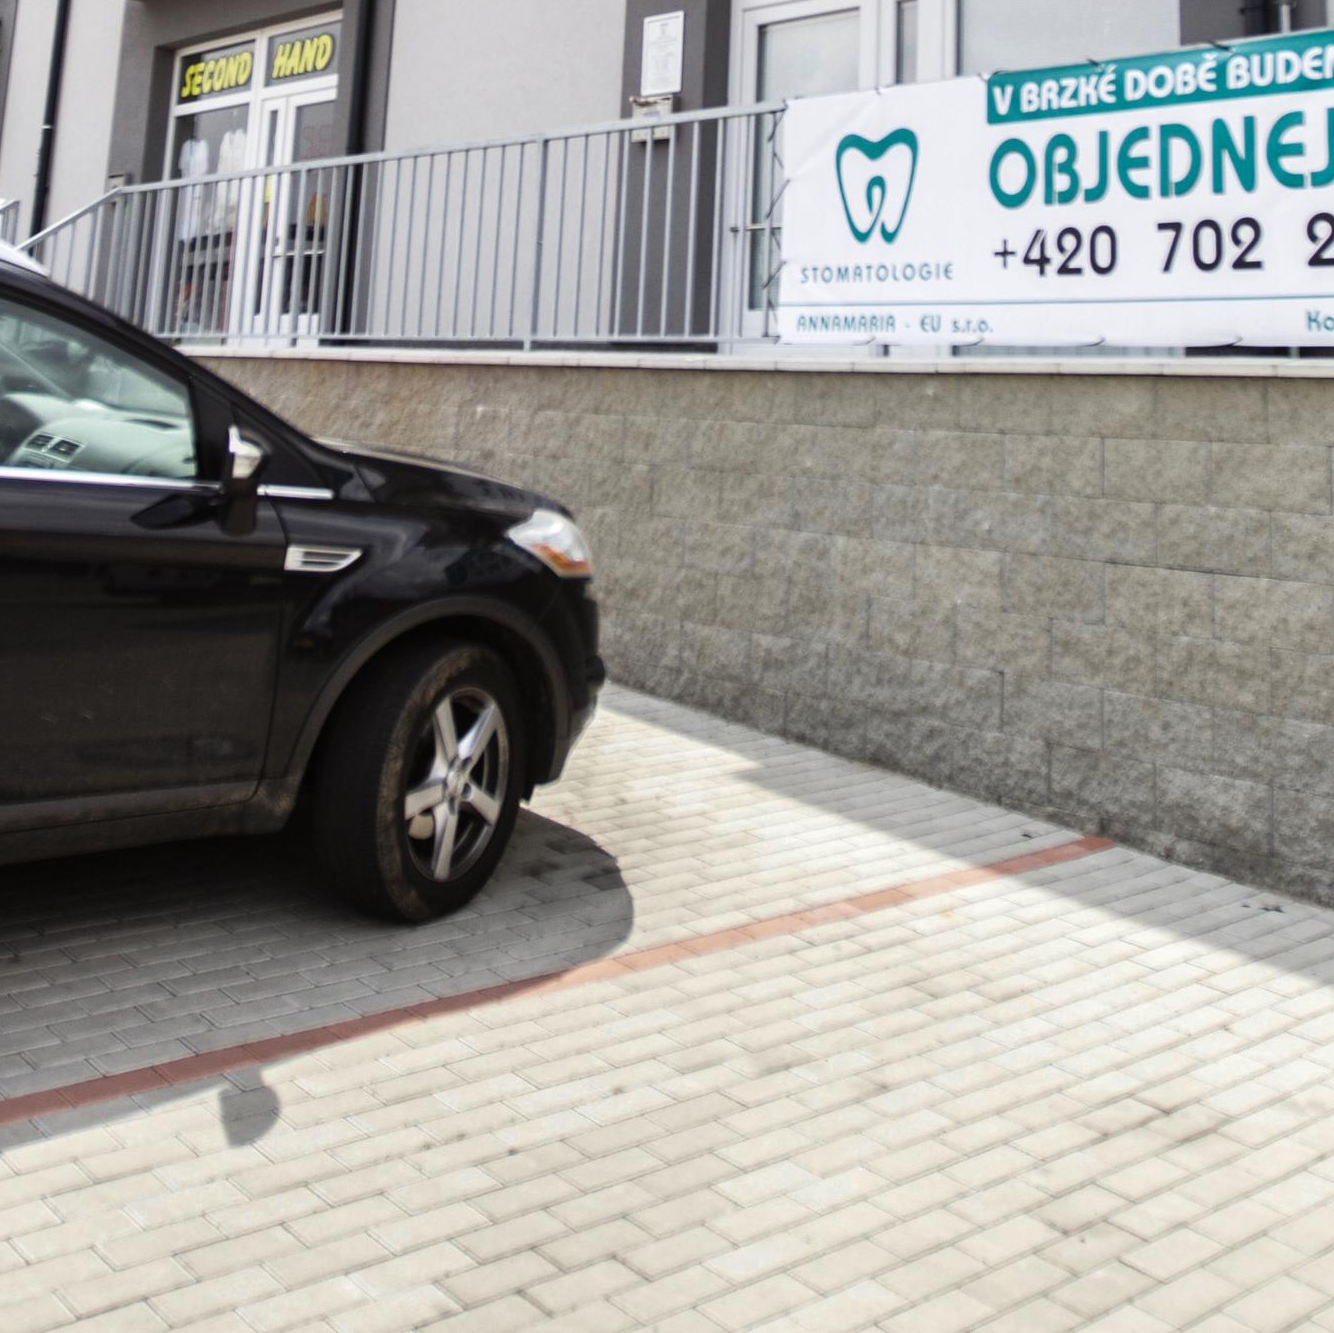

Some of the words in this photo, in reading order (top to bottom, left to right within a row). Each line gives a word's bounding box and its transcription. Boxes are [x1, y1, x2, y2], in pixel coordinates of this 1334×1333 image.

[180, 51, 254, 98] SECOND
[271, 32, 334, 79] HAND
[993, 85, 1014, 116] V
[1020, 64, 1117, 113] BRZKÉ
[1124, 52, 1217, 102] DOBĚ
[800, 263, 954, 284] STOMATOLOGIE
[994, 224, 1119, 278] +420
[1156, 216, 1264, 273] 702
[796, 315, 897, 333] ANNAMARIA
[920, 315, 942, 333] EU
